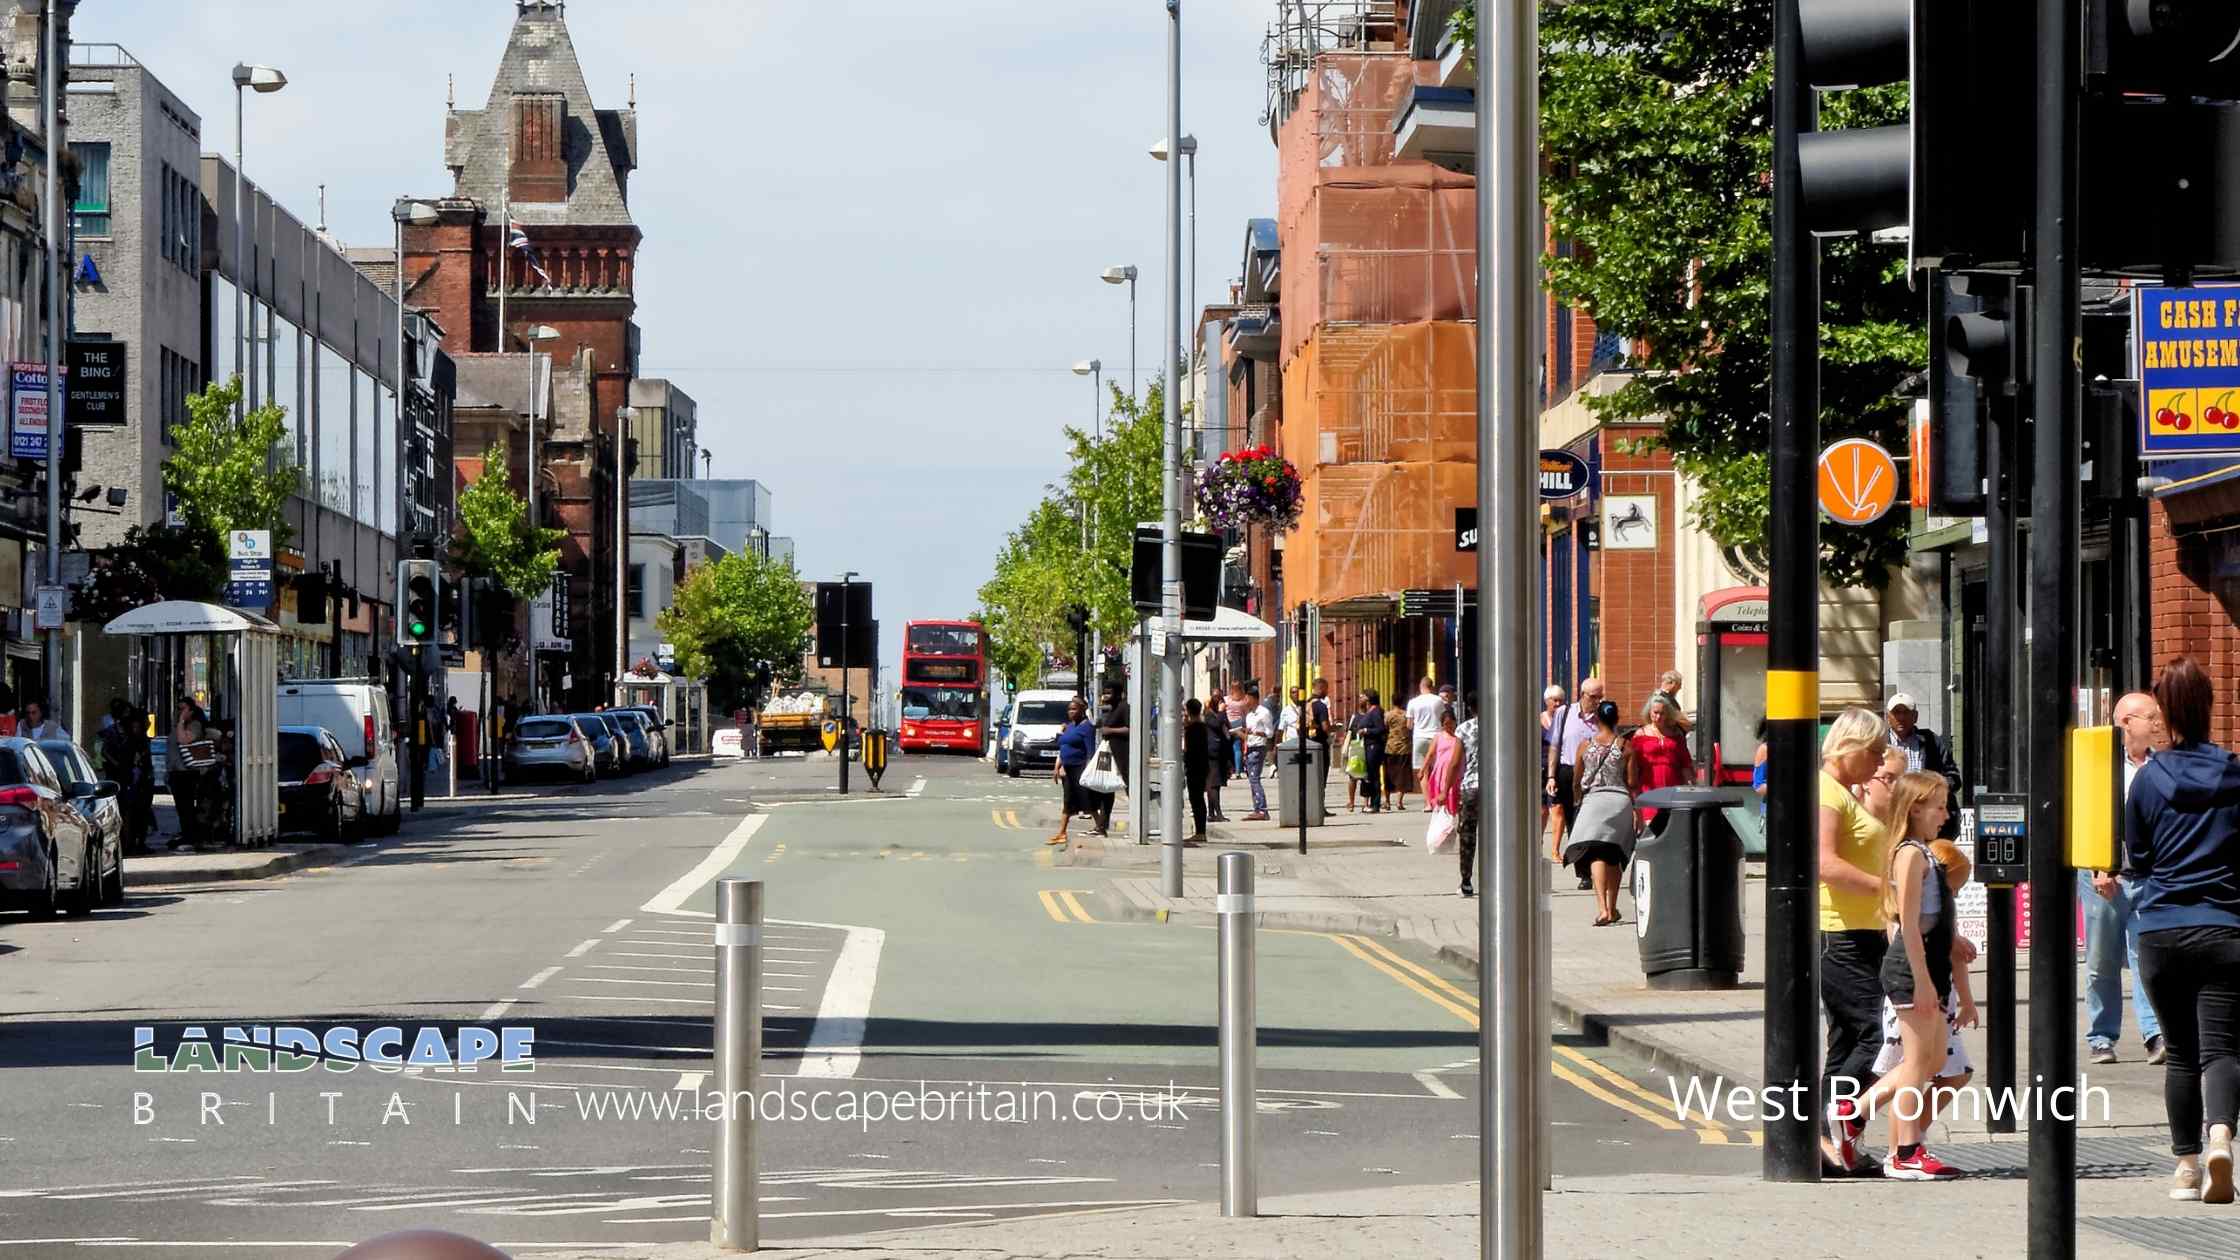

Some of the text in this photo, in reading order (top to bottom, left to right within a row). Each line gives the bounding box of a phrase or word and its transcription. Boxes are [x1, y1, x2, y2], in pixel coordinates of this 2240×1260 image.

[2160, 299, 2240, 328] CASH F
[84, 352, 108, 363] THE
[2145, 339, 2240, 368] AMUSEM
[15, 371, 63, 385] Cottos
[80, 366, 111, 378] BING
[86, 402, 106, 411] CLUB
[1540, 472, 1573, 489] HILL
[1458, 528, 1478, 547] SU
